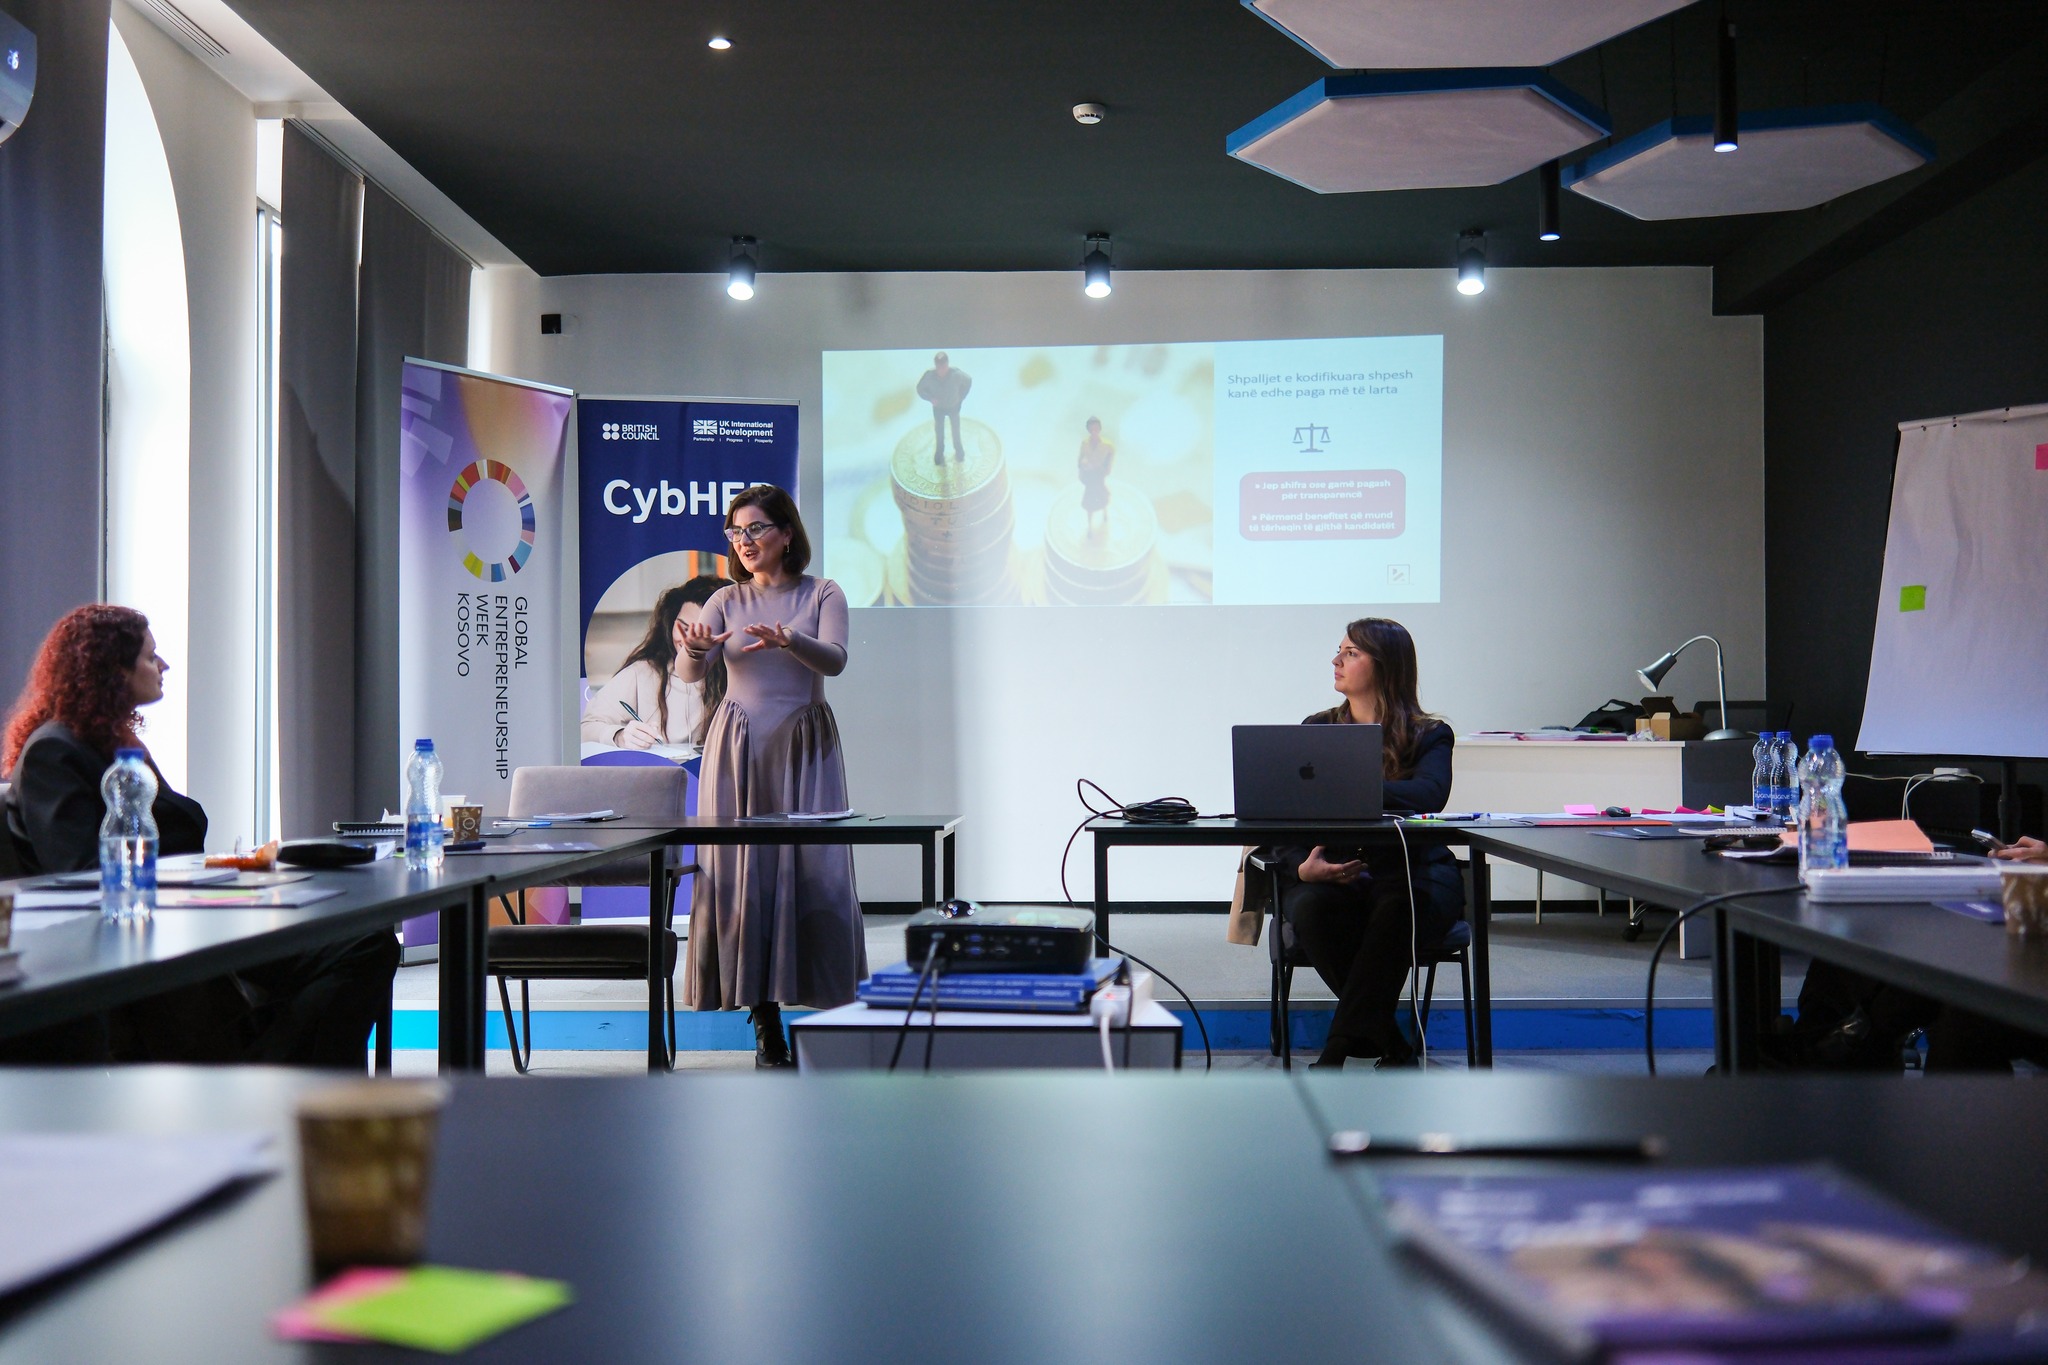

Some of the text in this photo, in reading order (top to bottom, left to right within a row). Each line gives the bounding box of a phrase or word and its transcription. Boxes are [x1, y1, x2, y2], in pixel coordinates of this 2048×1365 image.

[1227, 370, 1413, 386] Shpalljet e kodifikuara shpesh
[1228, 385, 1398, 399] kanë edhe paga më të larta
[621, 424, 658, 432] BRITISH
[719, 428, 774, 438] Development
[621, 432, 660, 441] COUNCIL
[1262, 482, 1279, 491] Jep
[1280, 481, 1307, 489] shifra
[1356, 480, 1391, 489] pagash
[603, 479, 774, 524] CybHE
[1281, 491, 1362, 500] për transparencë
[1305, 511, 1348, 520] benefitet
[1365, 511, 1393, 519] mund
[1344, 521, 1395, 530] kandidatët
[476, 594, 489, 646] WEEK
[457, 592, 470, 677] KOSOVO
[514, 596, 528, 669] GLOBAL
[495, 595, 508, 780] ENTREPRENEURSHIP
